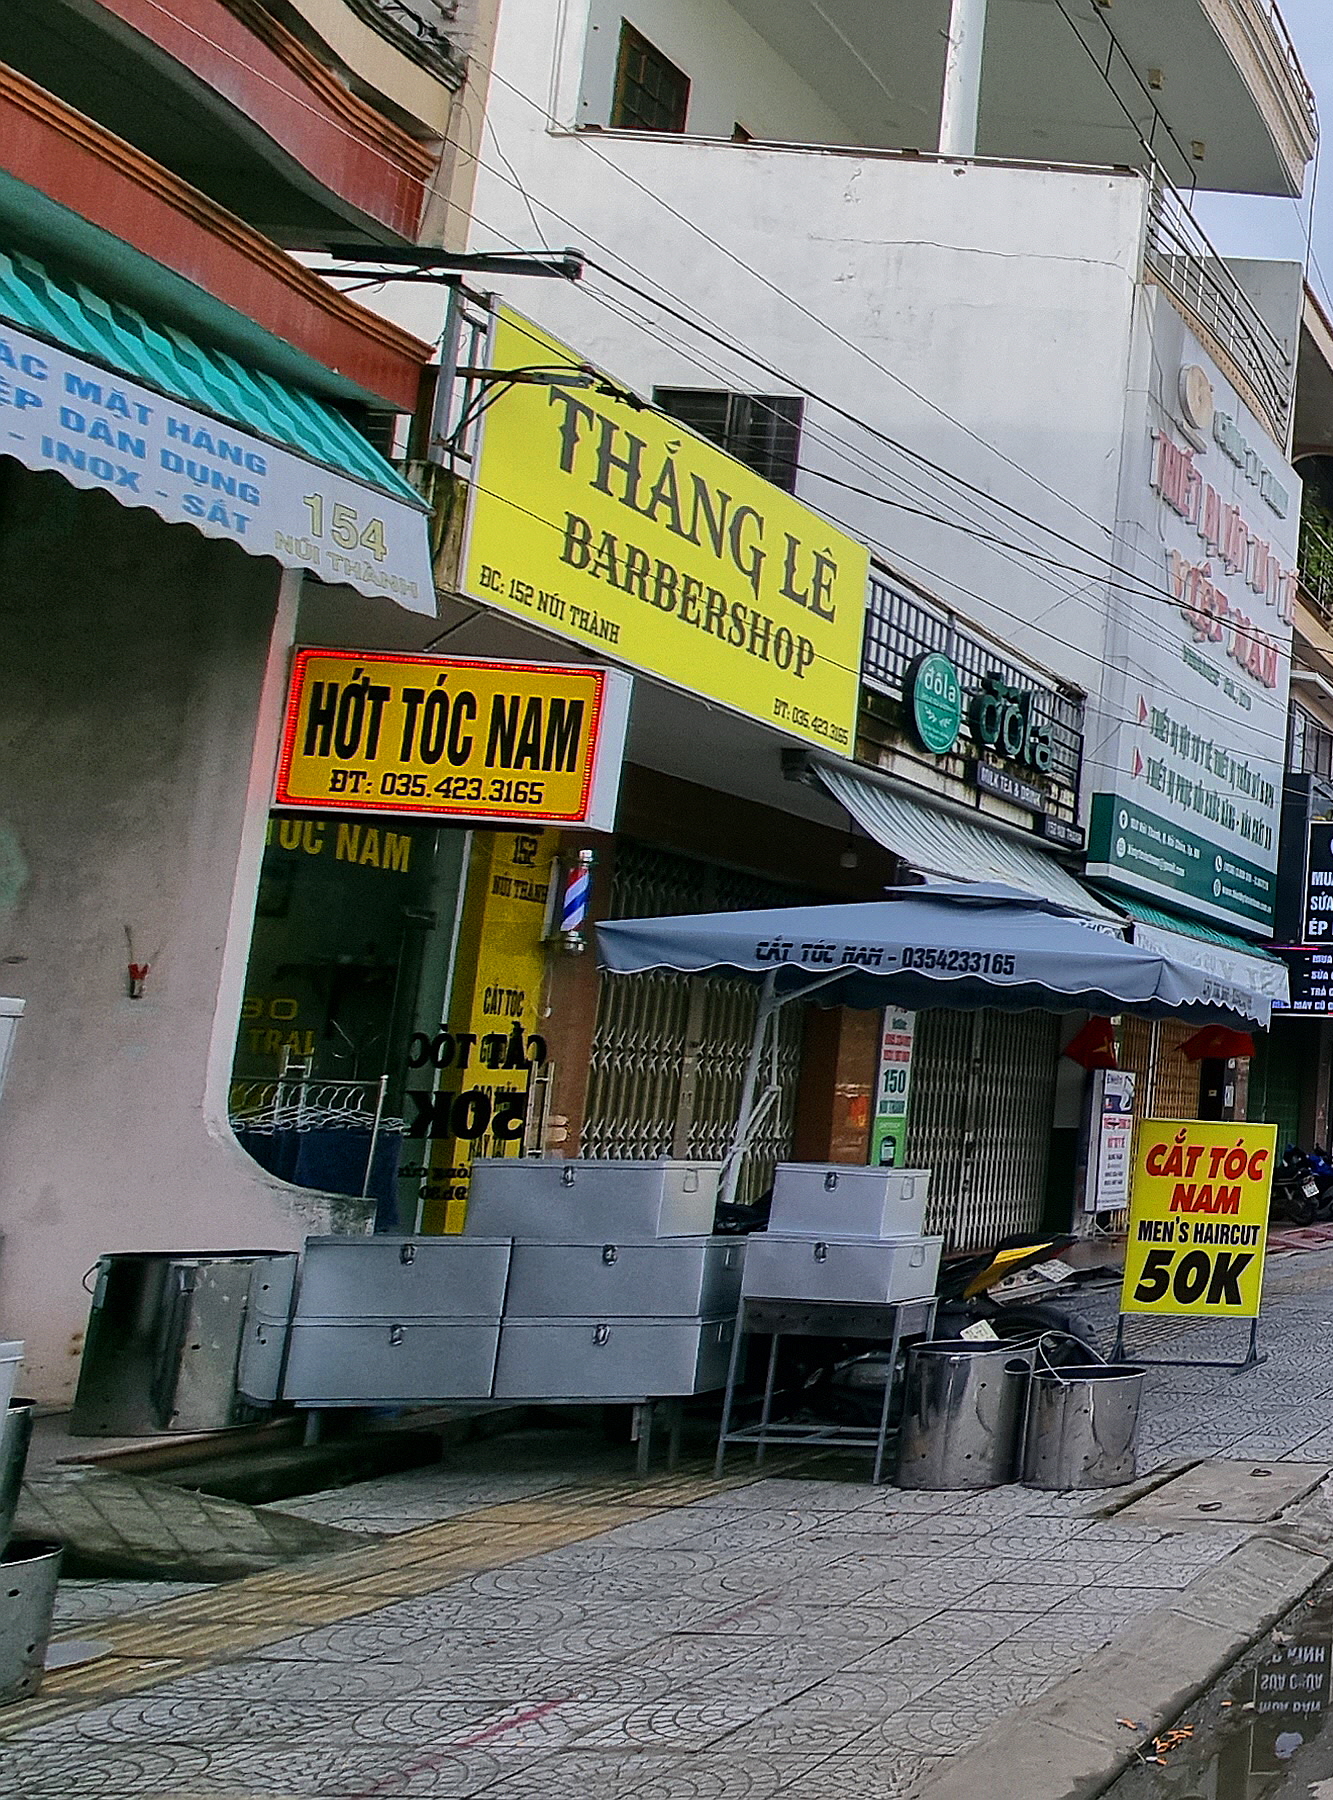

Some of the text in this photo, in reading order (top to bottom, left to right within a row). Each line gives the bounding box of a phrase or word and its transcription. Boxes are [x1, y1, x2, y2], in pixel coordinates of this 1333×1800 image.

[65, 370, 154, 427] MẶT
[166, 415, 268, 477] HÀNG
[41, 435, 142, 493] INOX
[182, 489, 251, 534] SẮT
[60, 407, 146, 459] DÂN
[160, 449, 261, 507] DỤNG
[303, 493, 388, 562] 154
[549, 385, 838, 624] THẮNG LÊ
[274, 530, 419, 599] NÚI THÀNH
[509, 578, 534, 608] 152
[538, 590, 565, 622] NÚI
[569, 605, 621, 645] THÀNH
[559, 511, 816, 680] BARBERSHOP
[303, 668, 584, 773] HỚT TÓC NAM
[329, 769, 544, 804] ĐT: 035.423.3165
[1000, 775, 1014, 795] TEA
[336, 823, 411, 873] NAM
[1308, 918, 1328, 935] ÉP
[1310, 891, 1333, 911] SỬA
[756, 935, 794, 961] CẮT
[801, 940, 836, 963] TÓC
[901, 947, 1015, 975] 0354233165
[883, 1069, 907, 1093] 150
[1146, 1127, 1205, 1178] CẮT
[1208, 1138, 1269, 1181] TÓC
[1169, 1183, 1242, 1215] NAM
[1137, 1216, 1261, 1246] MEN'S HAIRCUT
[1133, 1249, 1255, 1305] 50K
